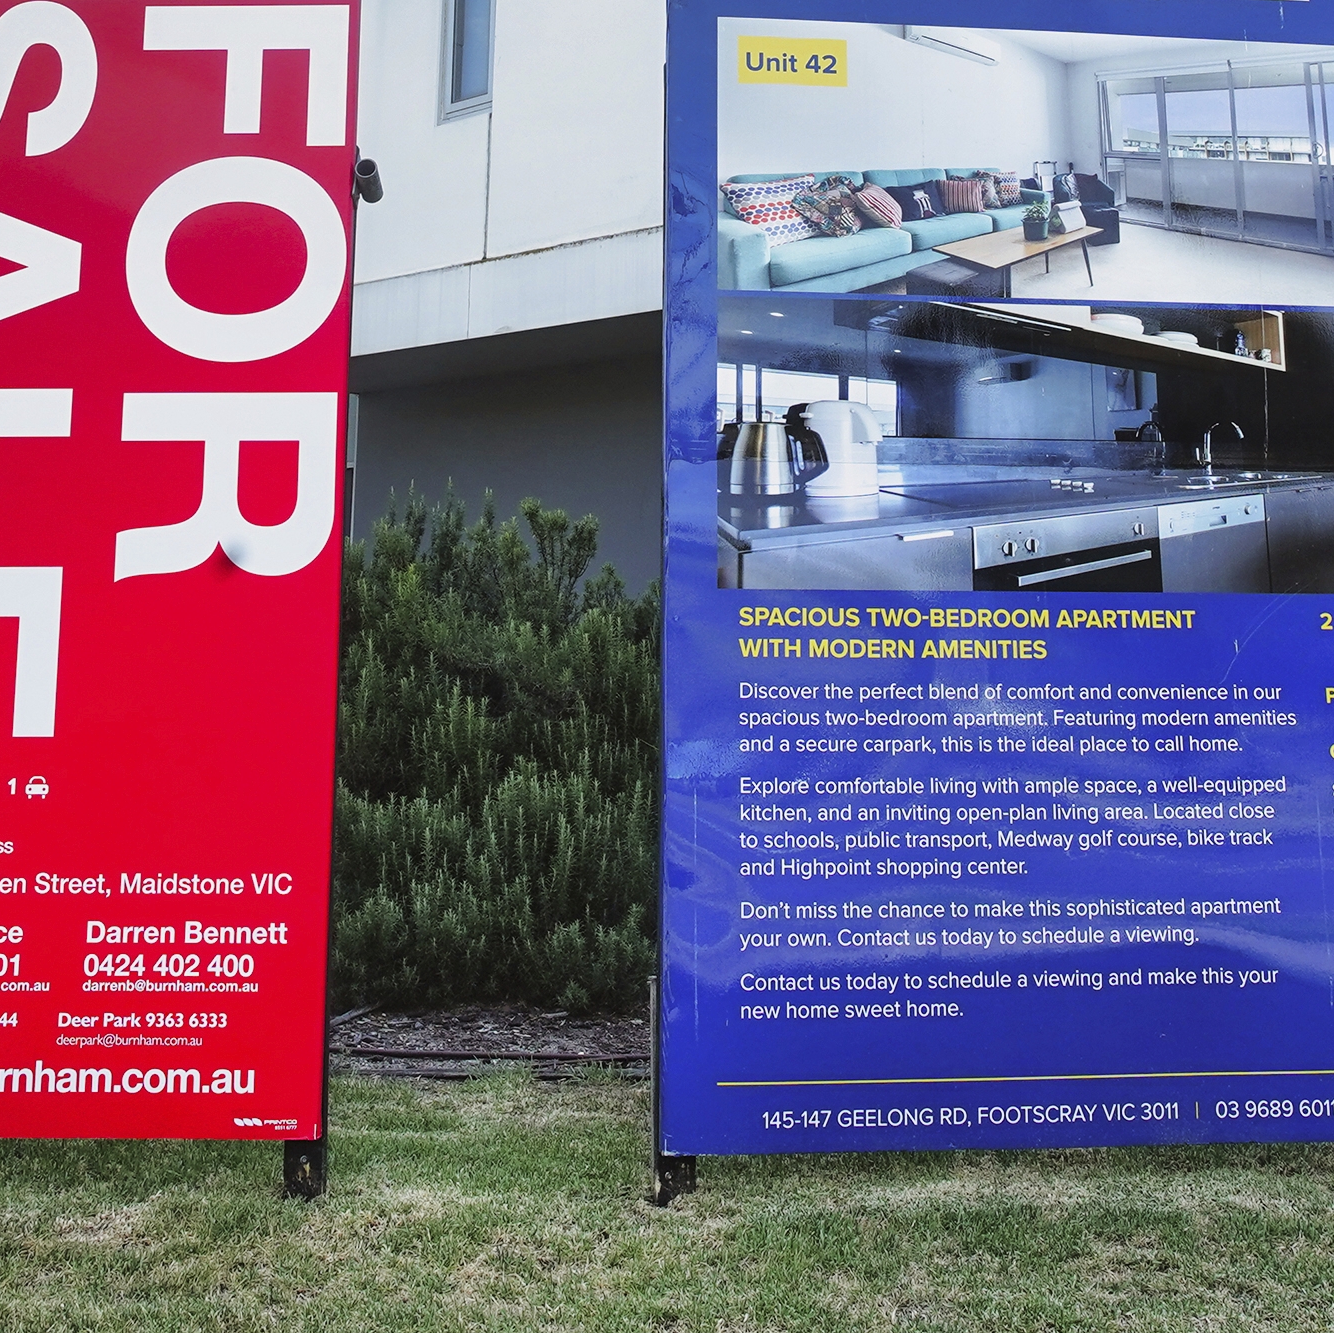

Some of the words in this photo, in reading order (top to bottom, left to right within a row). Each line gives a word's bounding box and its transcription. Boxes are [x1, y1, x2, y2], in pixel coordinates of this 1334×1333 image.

[746, 52, 798, 73] Unit
[805, 54, 837, 74] 42
[113, 4, 351, 583] FOR
[739, 607, 860, 627] SPACIOUS
[866, 608, 1050, 628] TWO-BEDROOM
[1056, 609, 1196, 629] APARTMENT
[1320, 612, 1333, 630] 2
[738, 638, 801, 658] WITH
[809, 638, 915, 659] MODERN
[921, 639, 1047, 659] AMENITIES
[739, 682, 820, 699] Discover
[823, 682, 854, 700] the
[859, 683, 924, 703] perfect
[929, 683, 979, 700] blend
[984, 683, 1003, 700] of
[1006, 683, 1075, 700] comfort
[1079, 683, 1112, 700] and
[1117, 684, 1229, 700] convenience
[1233, 684, 1248, 700] in
[1253, 687, 1282, 700] our
[739, 709, 820, 729] spacious
[824, 709, 947, 726] two-bedroom
[953, 708, 1048, 730] apartment.
[1053, 709, 1136, 731] Featuring
[1141, 709, 1209, 726] modern
[1214, 709, 1297, 726] amenities
[739, 735, 774, 752] and
[779, 739, 790, 752] a
[795, 739, 858, 752] secure
[863, 735, 937, 756] carpark,
[941, 735, 973, 753] this
[978, 736, 993, 752] is
[996, 735, 1027, 752] the
[1031, 735, 1074, 752] ideal
[1079, 735, 1127, 756] place
[1131, 736, 1150, 752] to
[1154, 735, 1184, 752] call
[1189, 735, 1243, 752] home.
[7, 778, 17, 795] 1
[740, 777, 810, 798] Explore
[814, 777, 925, 794] comfortable
[930, 777, 977, 798] living
[981, 777, 1019, 794] with
[1024, 777, 1079, 798] ample
[1084, 780, 1142, 797] space,
[1147, 780, 1157, 793] a
[1162, 775, 1286, 796] well-equipped
[34, 872, 111, 898] Street,
[120, 872, 245, 895] Maidstone
[251, 872, 293, 895] VIC
[86, 920, 176, 944] Darren
[184, 920, 288, 945] Bennett
[83, 953, 146, 977] 0424
[152, 953, 200, 977] 402
[207, 954, 254, 978] 400
[82, 979, 259, 993] darrenb@burnham.com.au
[57, 1012, 100, 1028] Deer
[103, 1012, 142, 1028] Park
[145, 1012, 184, 1028] 9363
[188, 1012, 228, 1028] 6333
[55, 1033, 203, 1049] deerpark@burnham.com.au
[762, 1110, 832, 1129] 145-147
[837, 1107, 934, 1128] GEELONG
[940, 1107, 972, 1127] RD,
[978, 1104, 1098, 1125] FOOTSCRAY
[1102, 1103, 1136, 1121] VIC
[1140, 1102, 1179, 1120] 3011
[1215, 1100, 1240, 1119] 03
[1244, 1099, 1294, 1118] 9689
